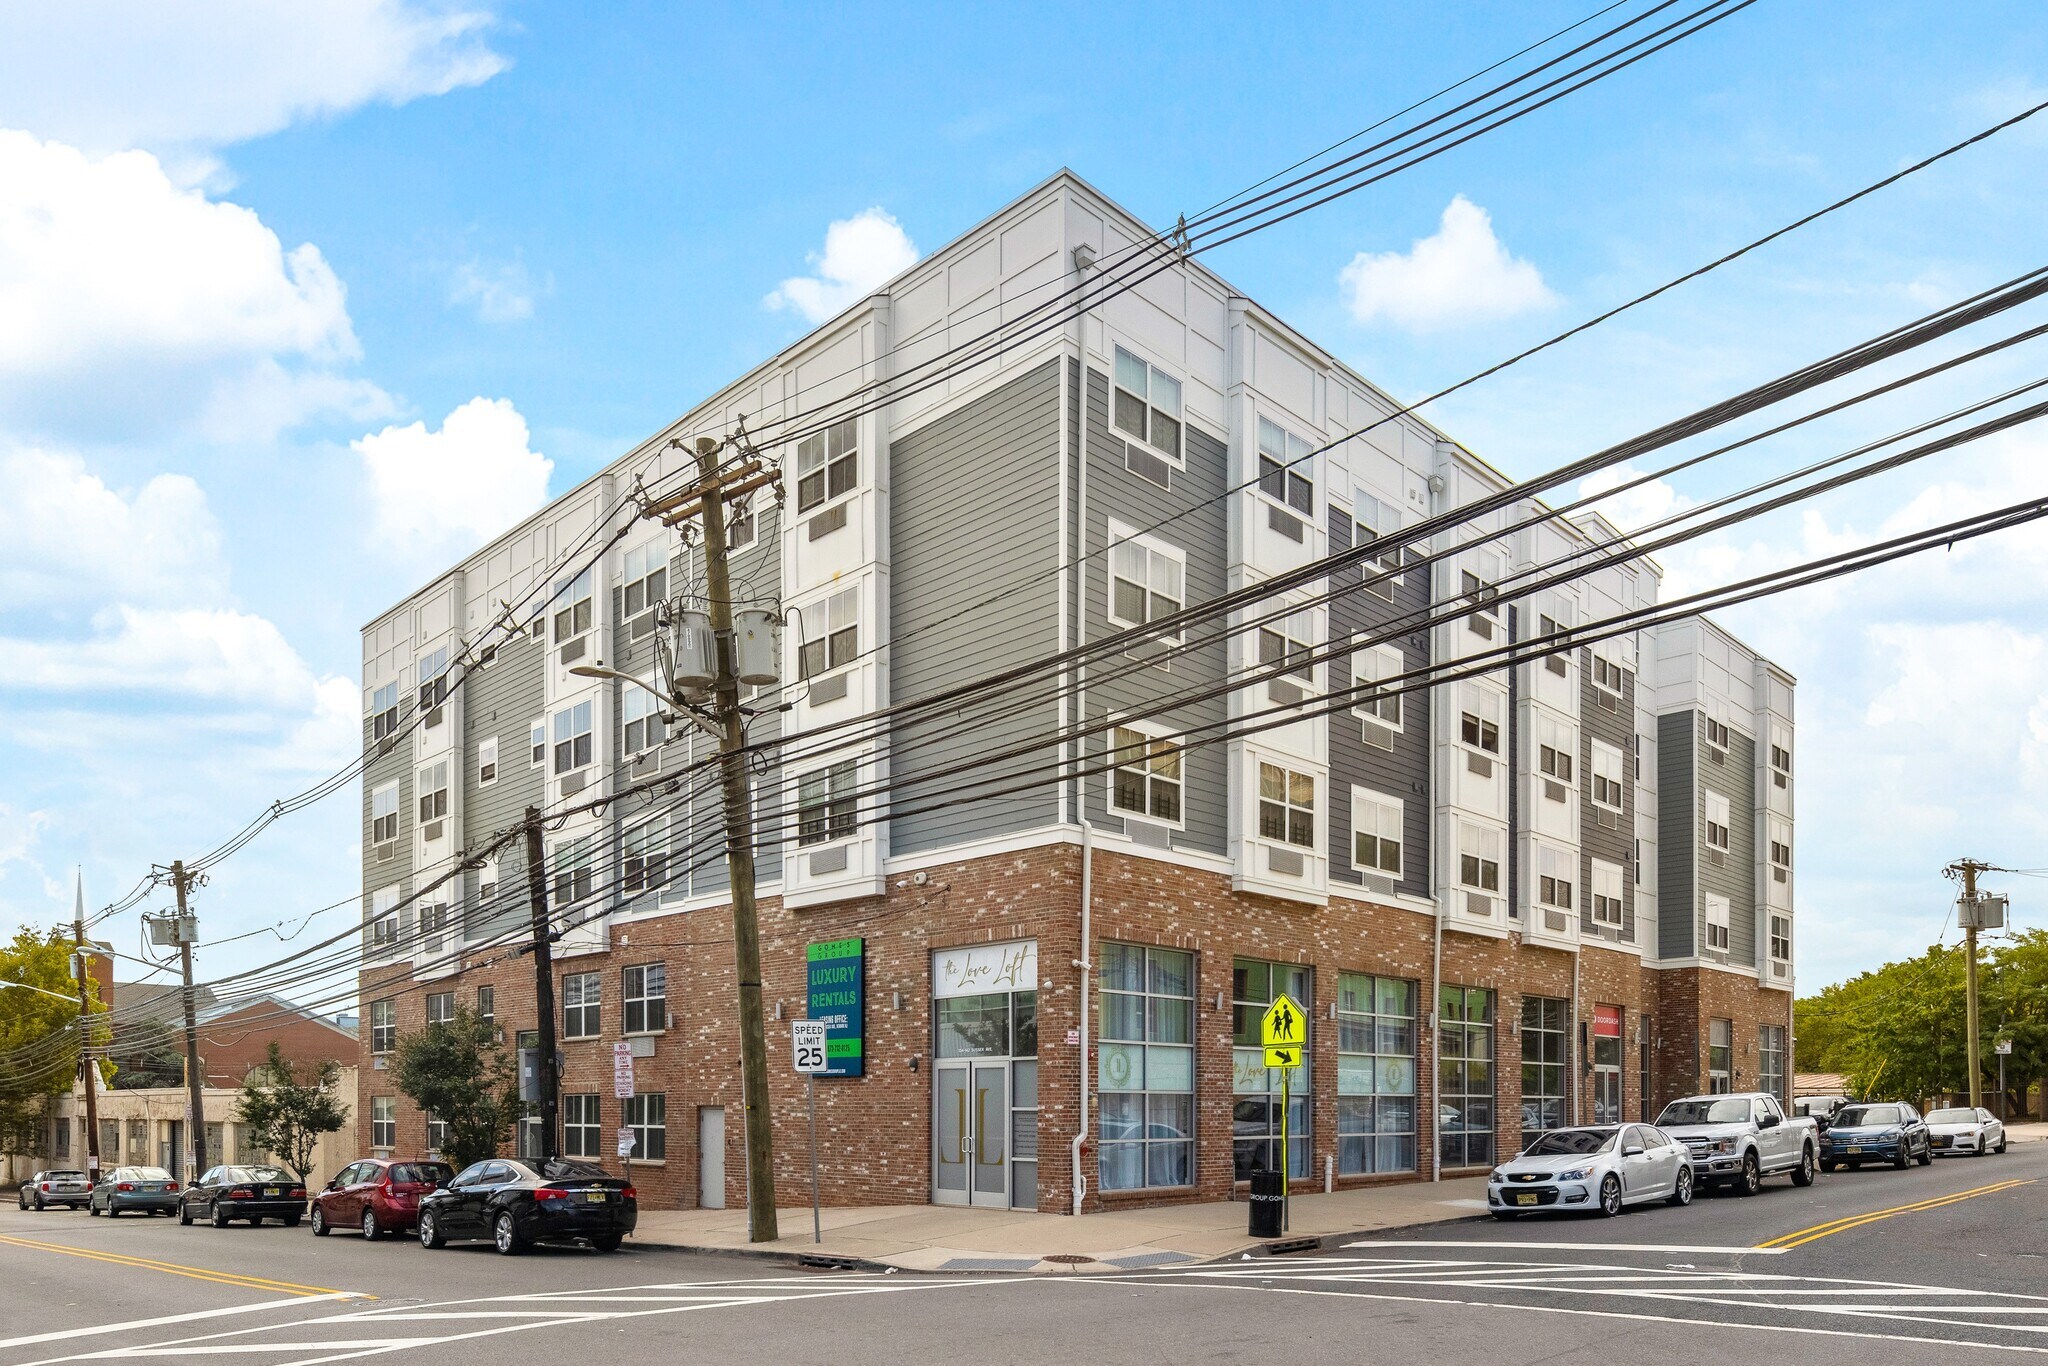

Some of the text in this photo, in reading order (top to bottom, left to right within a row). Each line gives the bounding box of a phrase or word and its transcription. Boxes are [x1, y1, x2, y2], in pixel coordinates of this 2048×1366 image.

[817, 941, 851, 952] GOMES
[817, 950, 851, 960] GROUP
[942, 944, 1037, 988] the Love Loft
[811, 965, 857, 986] LUXURY
[811, 990, 857, 1008] RENTALS
[1597, 1016, 1619, 1025] DOORDASH
[794, 1025, 824, 1035] SPEED
[797, 1036, 821, 1046] LIMIT
[797, 1047, 823, 1068] 25
[1250, 1193, 1268, 1201] GROUP
